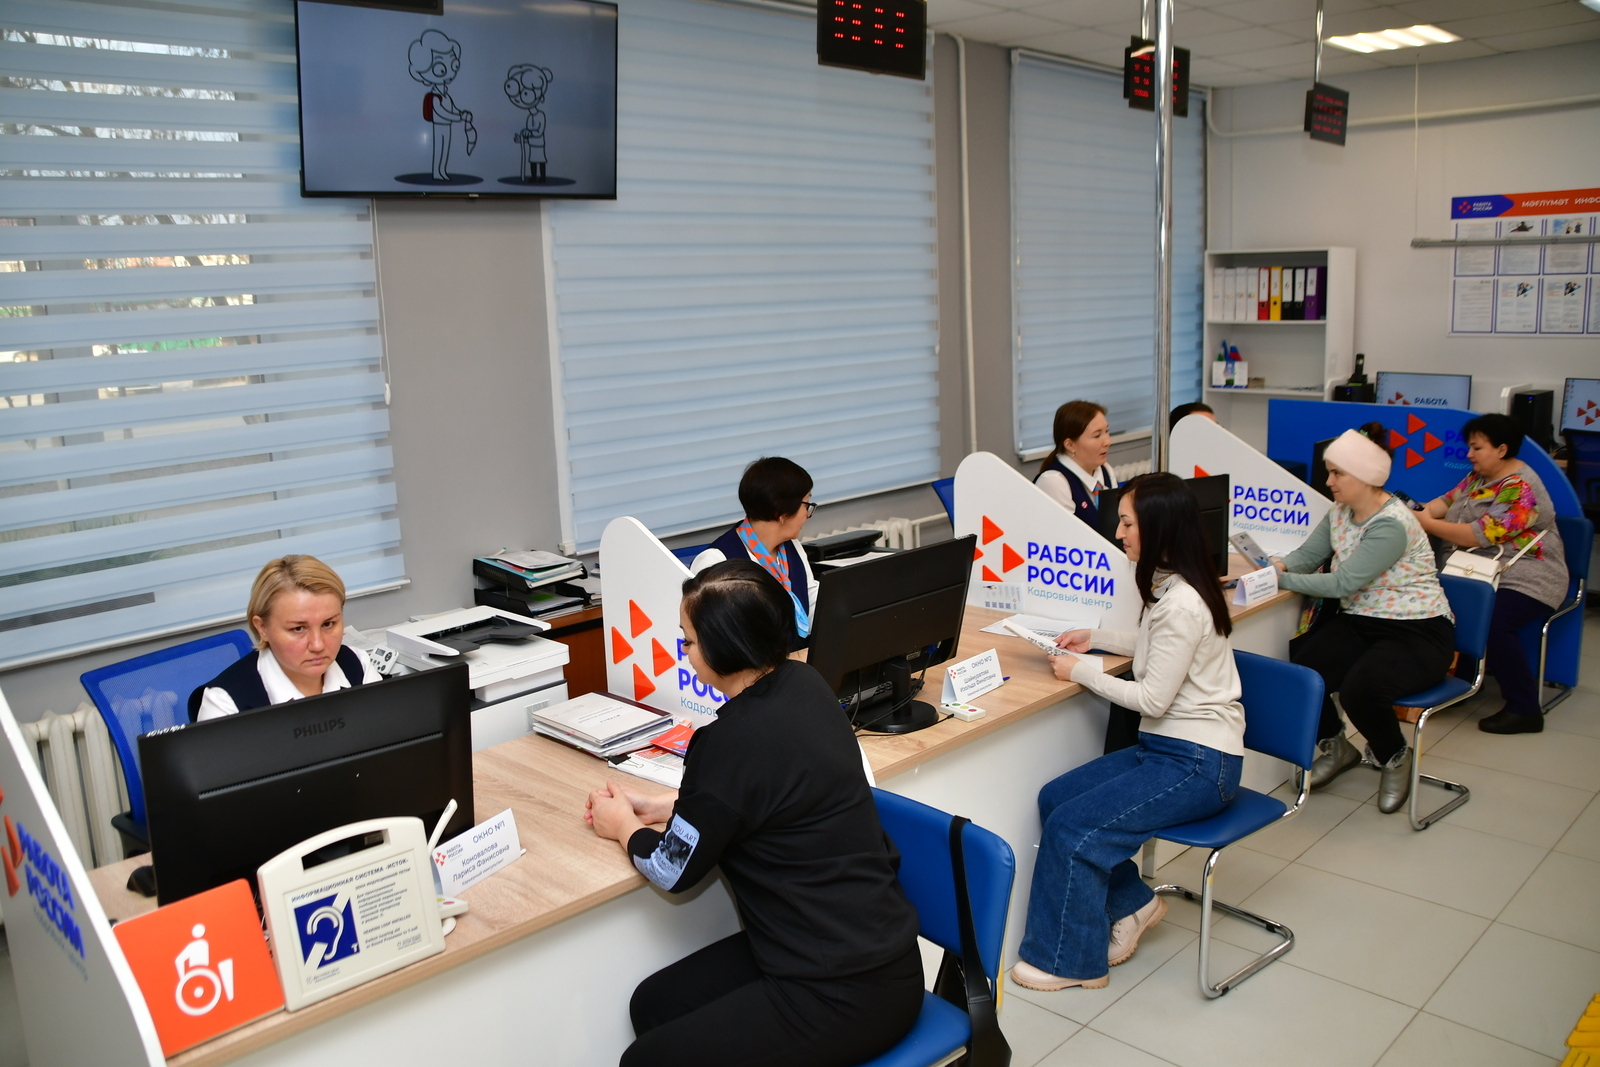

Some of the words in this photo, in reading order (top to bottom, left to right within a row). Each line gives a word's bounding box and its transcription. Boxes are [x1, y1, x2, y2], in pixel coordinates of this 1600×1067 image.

[1445, 430, 1467, 443] РА
[1444, 446, 1469, 460] РО
[1234, 485, 1307, 507] РАБОТА
[1233, 503, 1309, 526] РОССИИ
[1233, 520, 1278, 533] Кадровый
[1280, 527, 1308, 537] центр
[1027, 542, 1111, 571] РАБОТА
[1027, 565, 1114, 596] РОССИИ
[1027, 586, 1079, 603] Кадровый
[1081, 597, 1113, 610] центр
[971, 659, 985, 669] ОКНО
[678, 667, 730, 702] РОС
[680, 696, 719, 718] Кадров
[293, 717, 346, 740] PHILIPS
[472, 827, 494, 844] ОКНО
[494, 820, 506, 832] №1
[672, 823, 685, 836] YOU
[684, 831, 697, 844] ART
[446, 844, 461, 854] РАБОТА
[448, 847, 464, 859] РОССИИ
[461, 842, 498, 867] Коновалова
[452, 864, 476, 882] Лариса
[476, 844, 510, 868] Фанисовна
[291, 877, 354, 903] ИНФОРМАЦИОННАЯ
[354, 866, 384, 882] СИСТЕМА
[24, 863, 85, 959] РОССИИ
